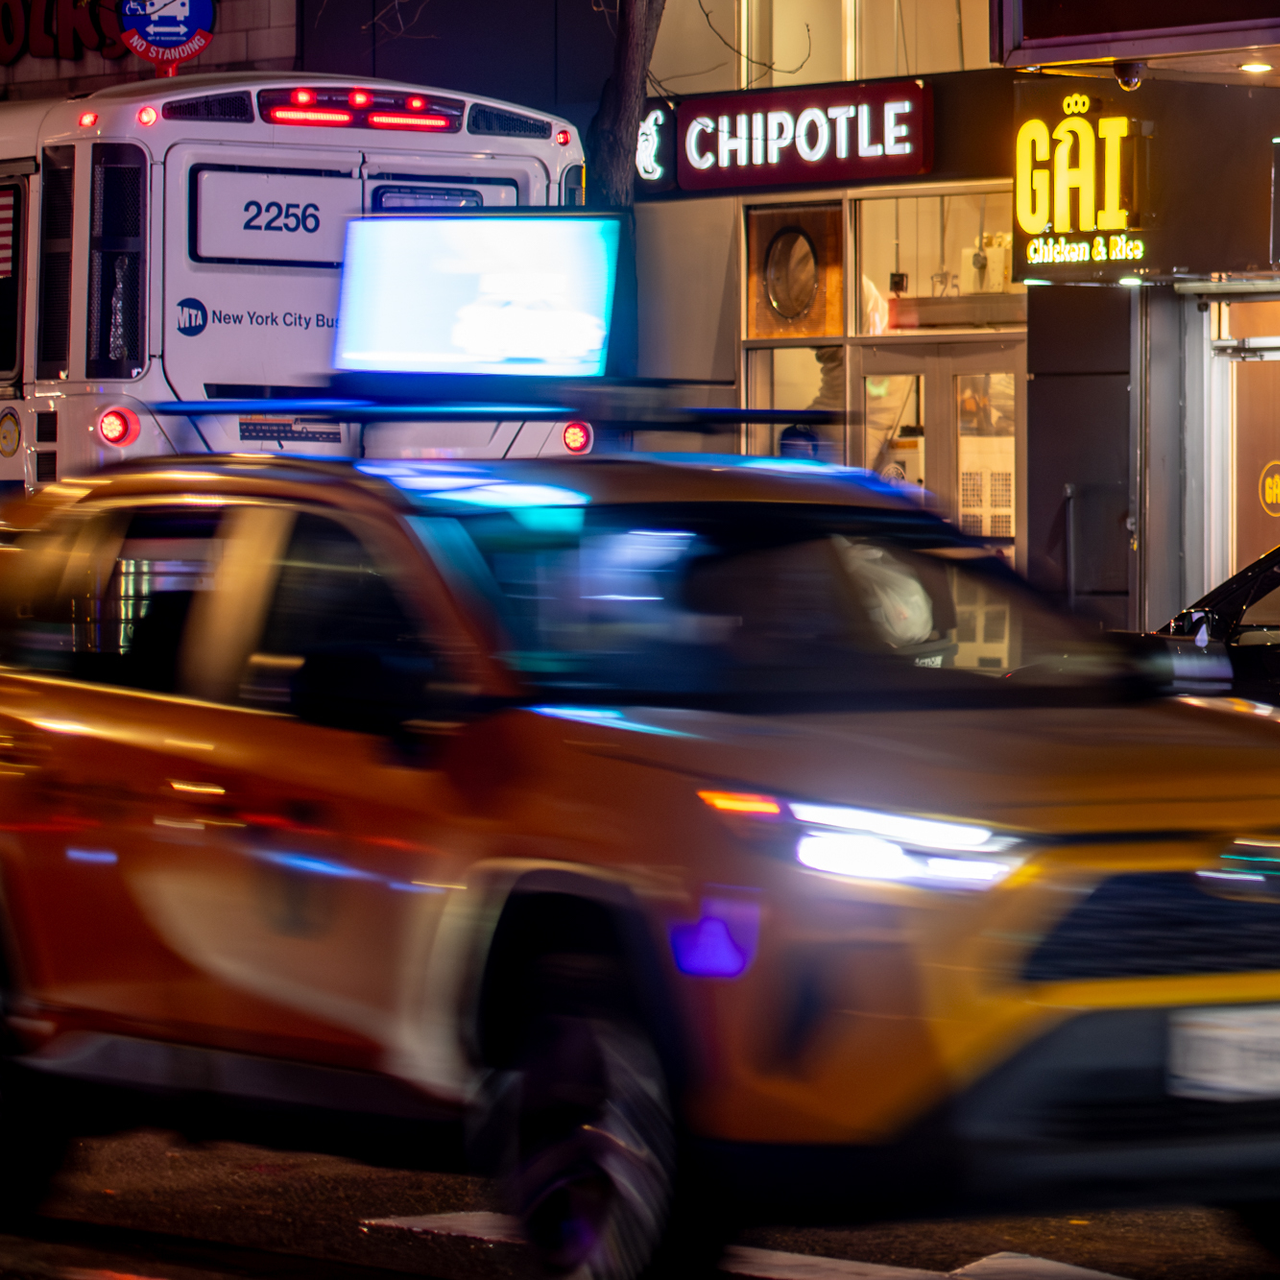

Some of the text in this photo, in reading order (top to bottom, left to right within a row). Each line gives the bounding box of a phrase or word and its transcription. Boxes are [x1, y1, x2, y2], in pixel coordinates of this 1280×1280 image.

[129, 34, 206, 60] NO STANDING
[685, 100, 913, 170] CHIPOTLE
[243, 201, 321, 233] 2256
[1027, 235, 1144, 264] Chicken & Rice
[177, 306, 203, 329] MTA
[212, 310, 243, 325] New
[247, 311, 279, 326] York
[283, 312, 311, 330] City
